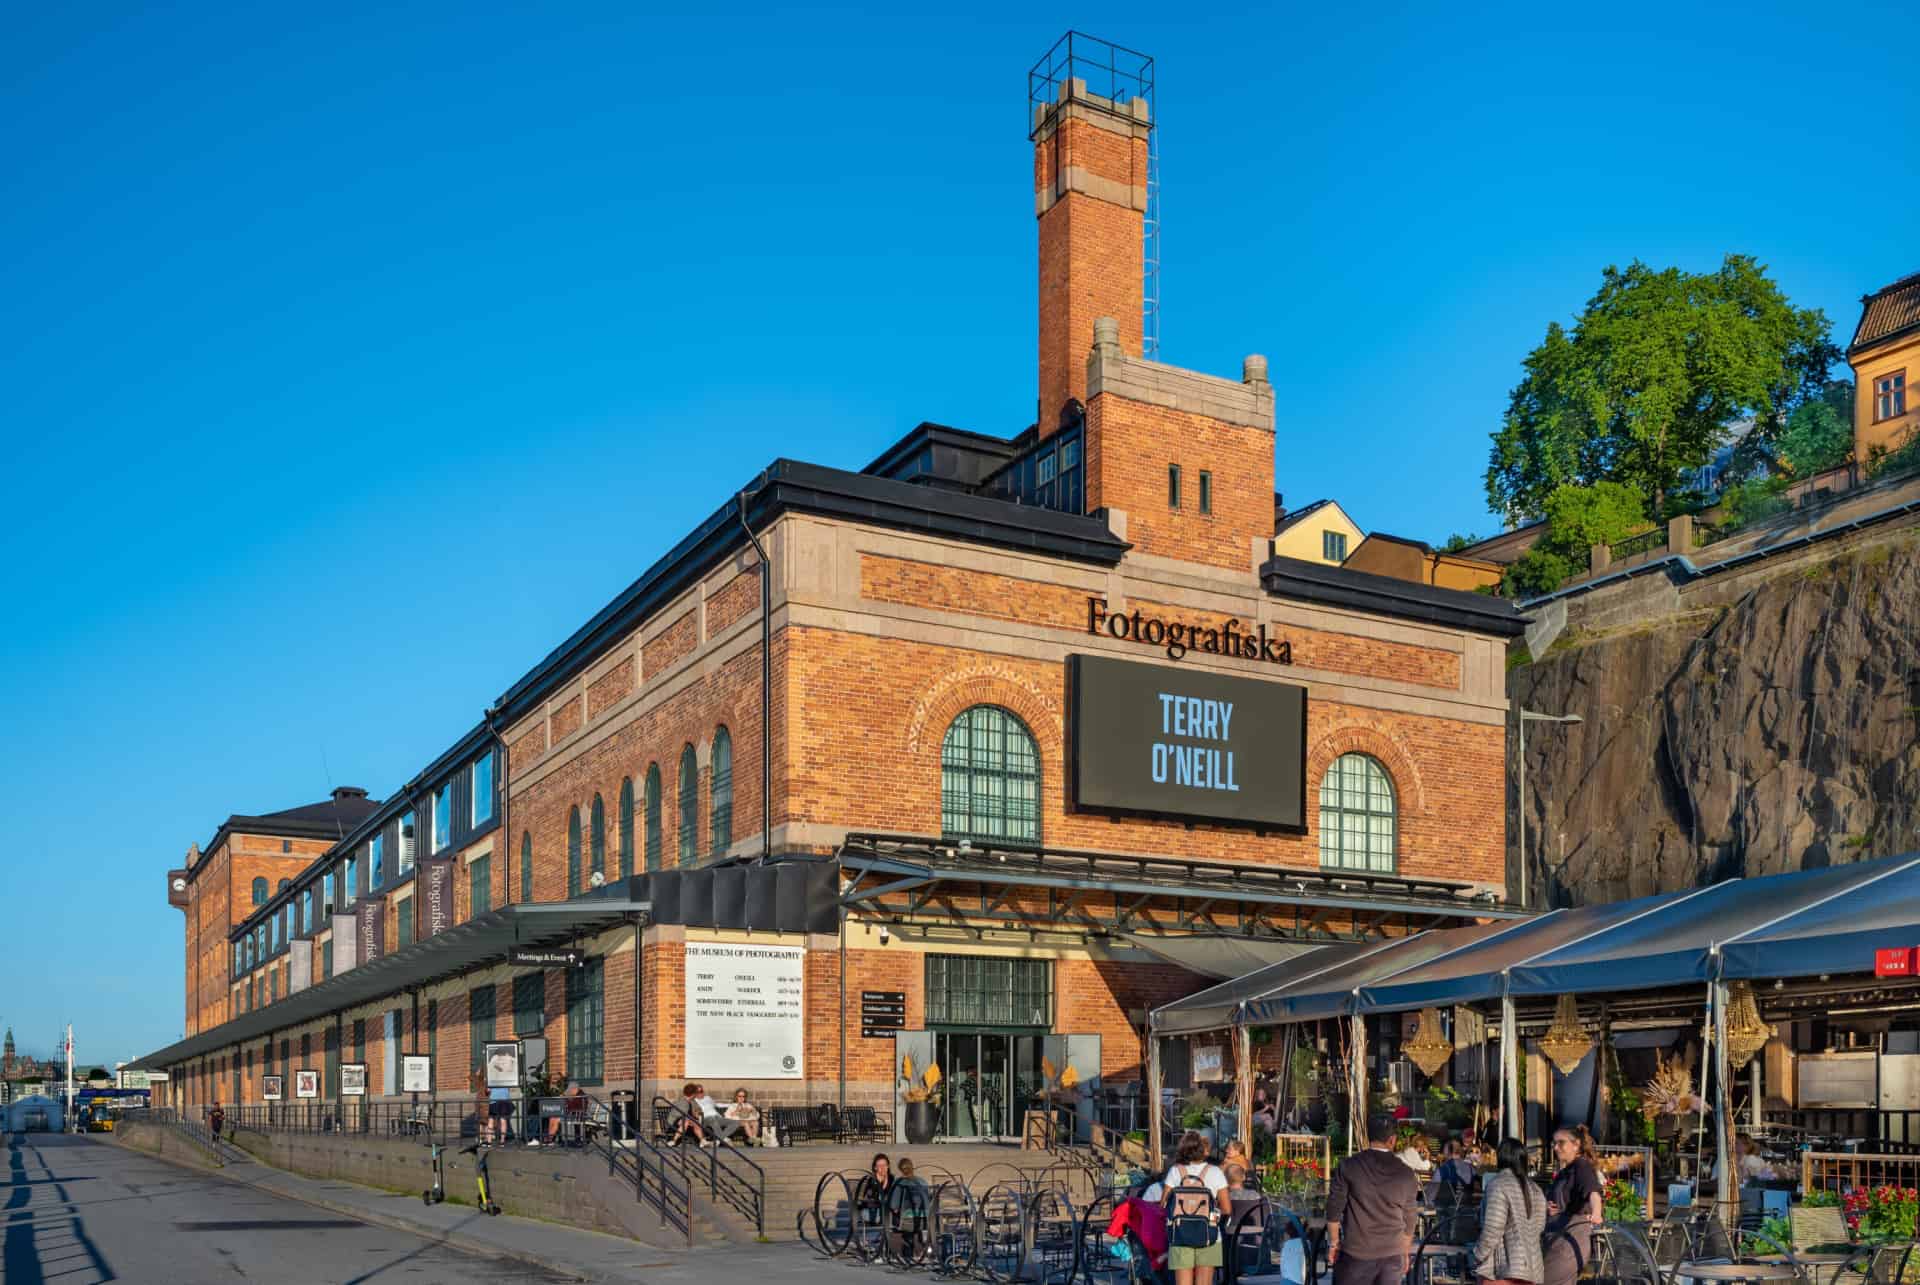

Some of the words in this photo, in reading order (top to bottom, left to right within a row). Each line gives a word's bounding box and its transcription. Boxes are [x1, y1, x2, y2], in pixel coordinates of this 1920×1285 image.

[1087, 597, 1292, 665] Fotografiska
[1158, 693, 1233, 741] TERRY
[1152, 743, 1239, 791] O'NEILL
[427, 865, 446, 936] Fotografisk
[361, 903, 377, 961] Fotografisk
[685, 947, 699, 956] THE
[701, 948, 733, 957] MUSEUM
[735, 949, 744, 957] OF
[745, 950, 800, 960] PHOTOGRAPHY
